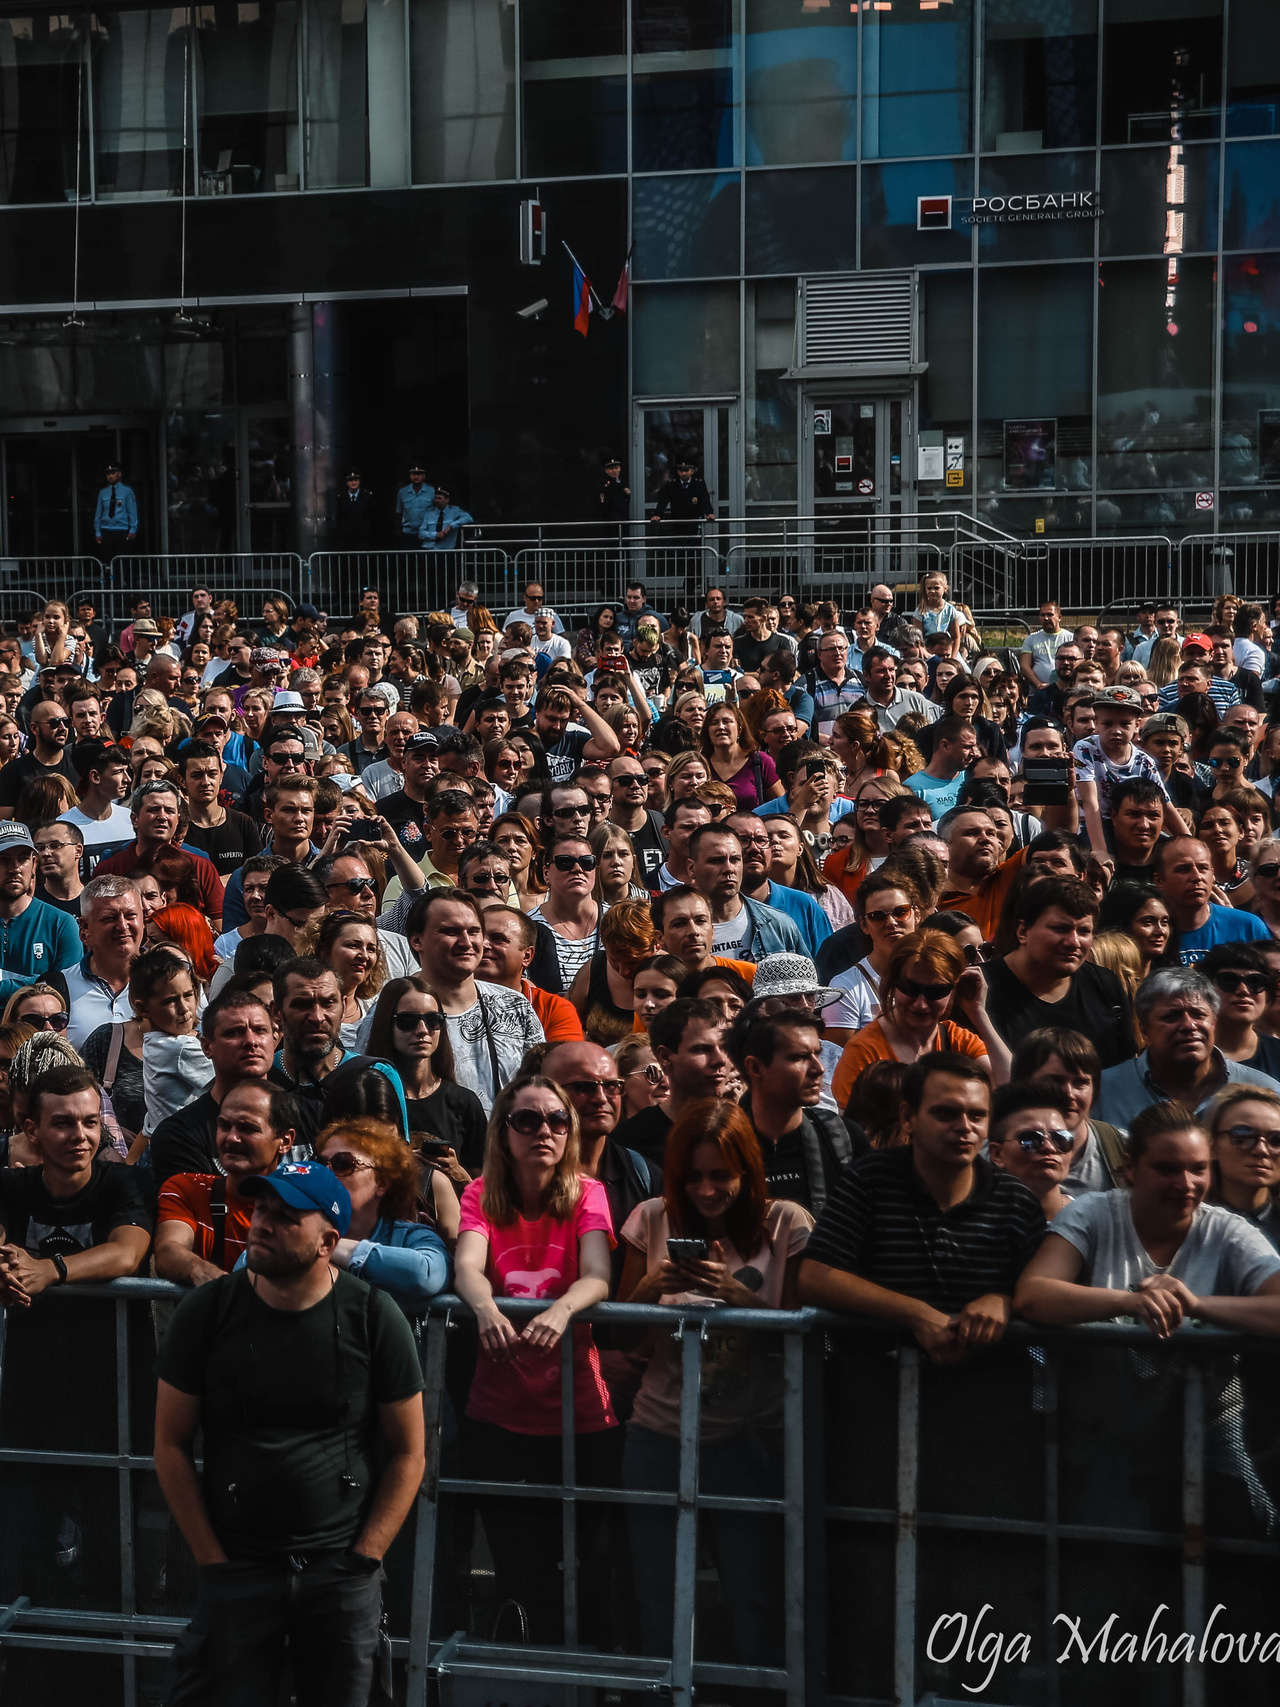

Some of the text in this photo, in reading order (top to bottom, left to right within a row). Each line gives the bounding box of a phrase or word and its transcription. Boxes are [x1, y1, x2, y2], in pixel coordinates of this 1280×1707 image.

[972, 191, 1093, 213] РОСБАНК
[961, 208, 1105, 224] SOCIETE GENERALE GROUP
[549, 762, 571, 776] YORK
[765, 1172, 800, 1183] KIPSTA
